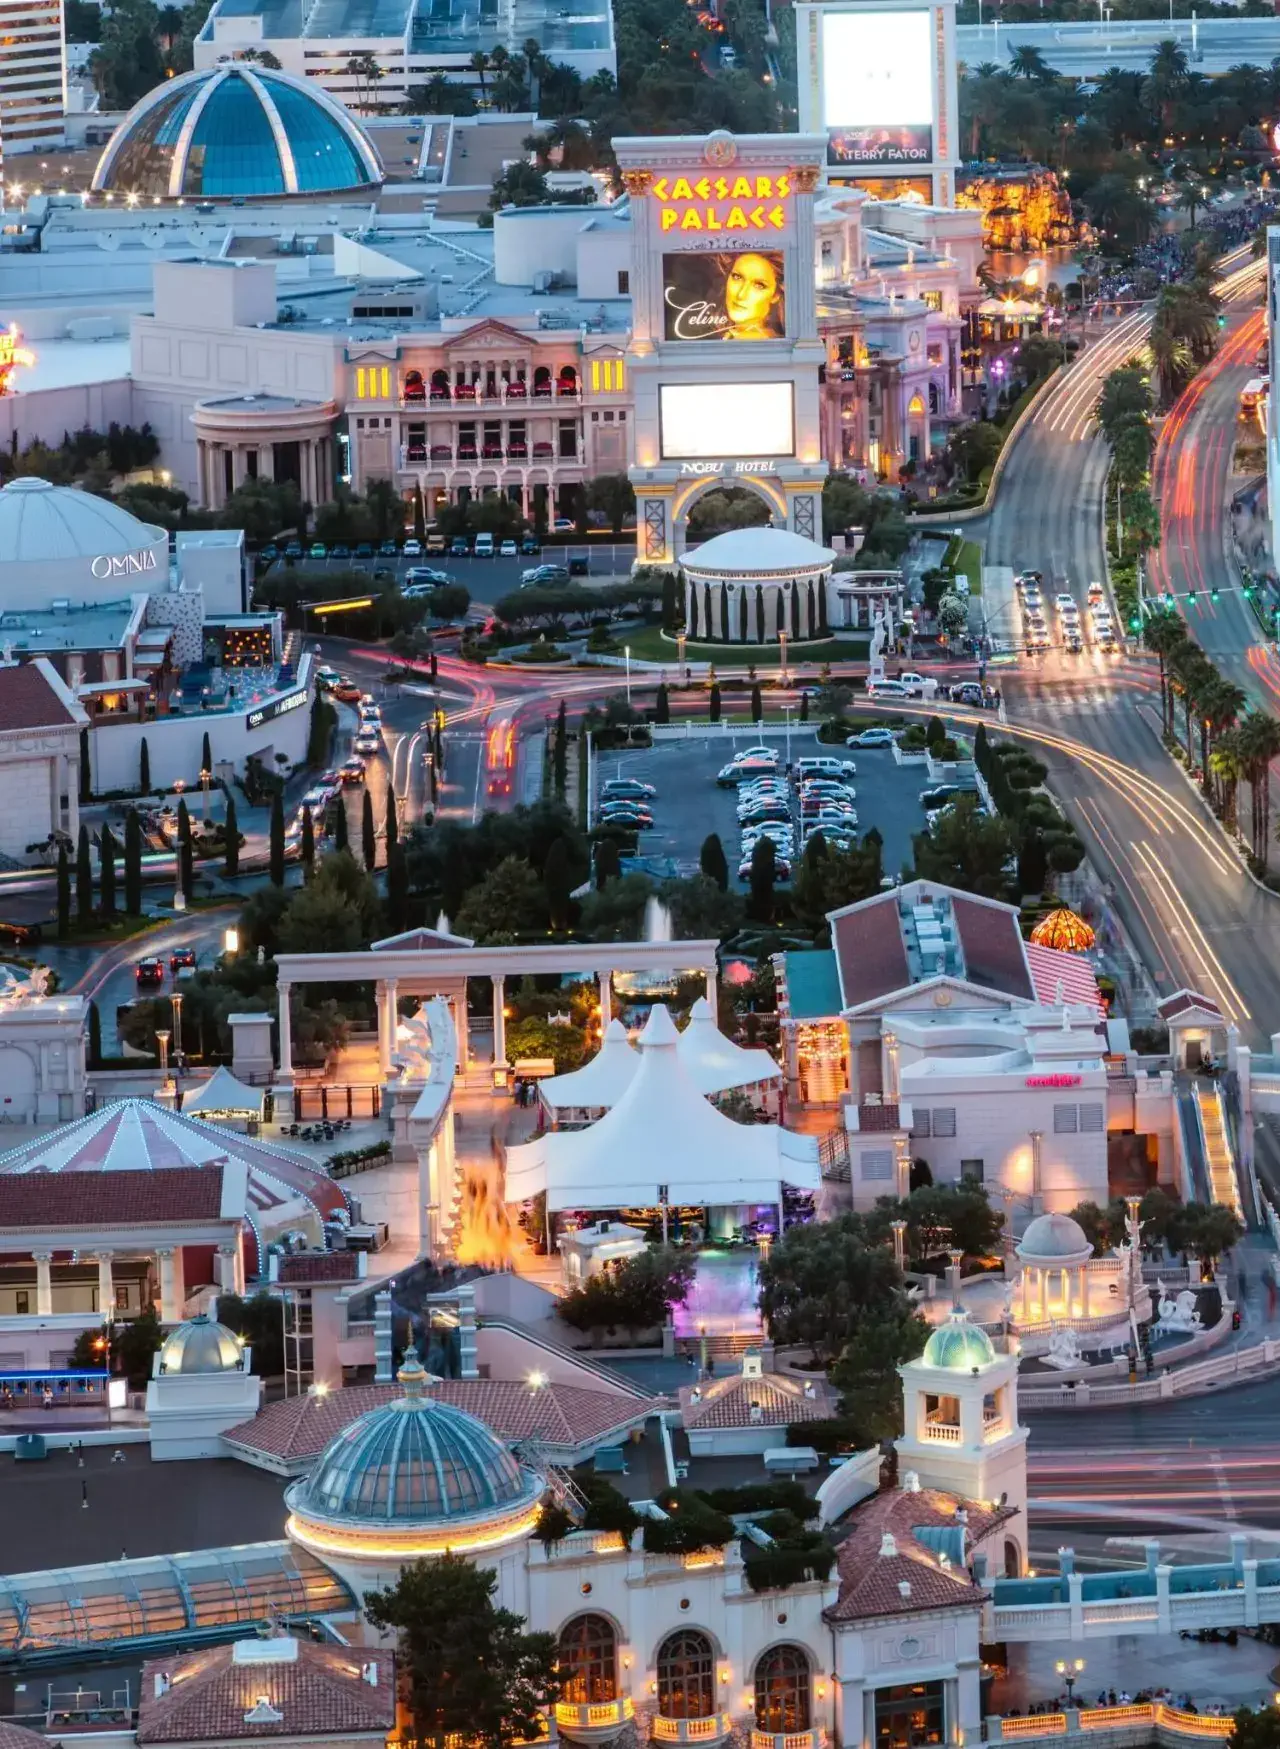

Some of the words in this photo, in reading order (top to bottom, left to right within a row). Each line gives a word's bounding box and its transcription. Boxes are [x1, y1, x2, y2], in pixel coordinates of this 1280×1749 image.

[848, 149, 886, 160] TERRY
[888, 149, 928, 160] FATOR
[653, 176, 791, 201] CAESARS
[661, 204, 785, 231] PALACE
[681, 462, 724, 475] NOBU
[735, 461, 776, 473] HOTEL
[91, 550, 157, 579] OMNIA
